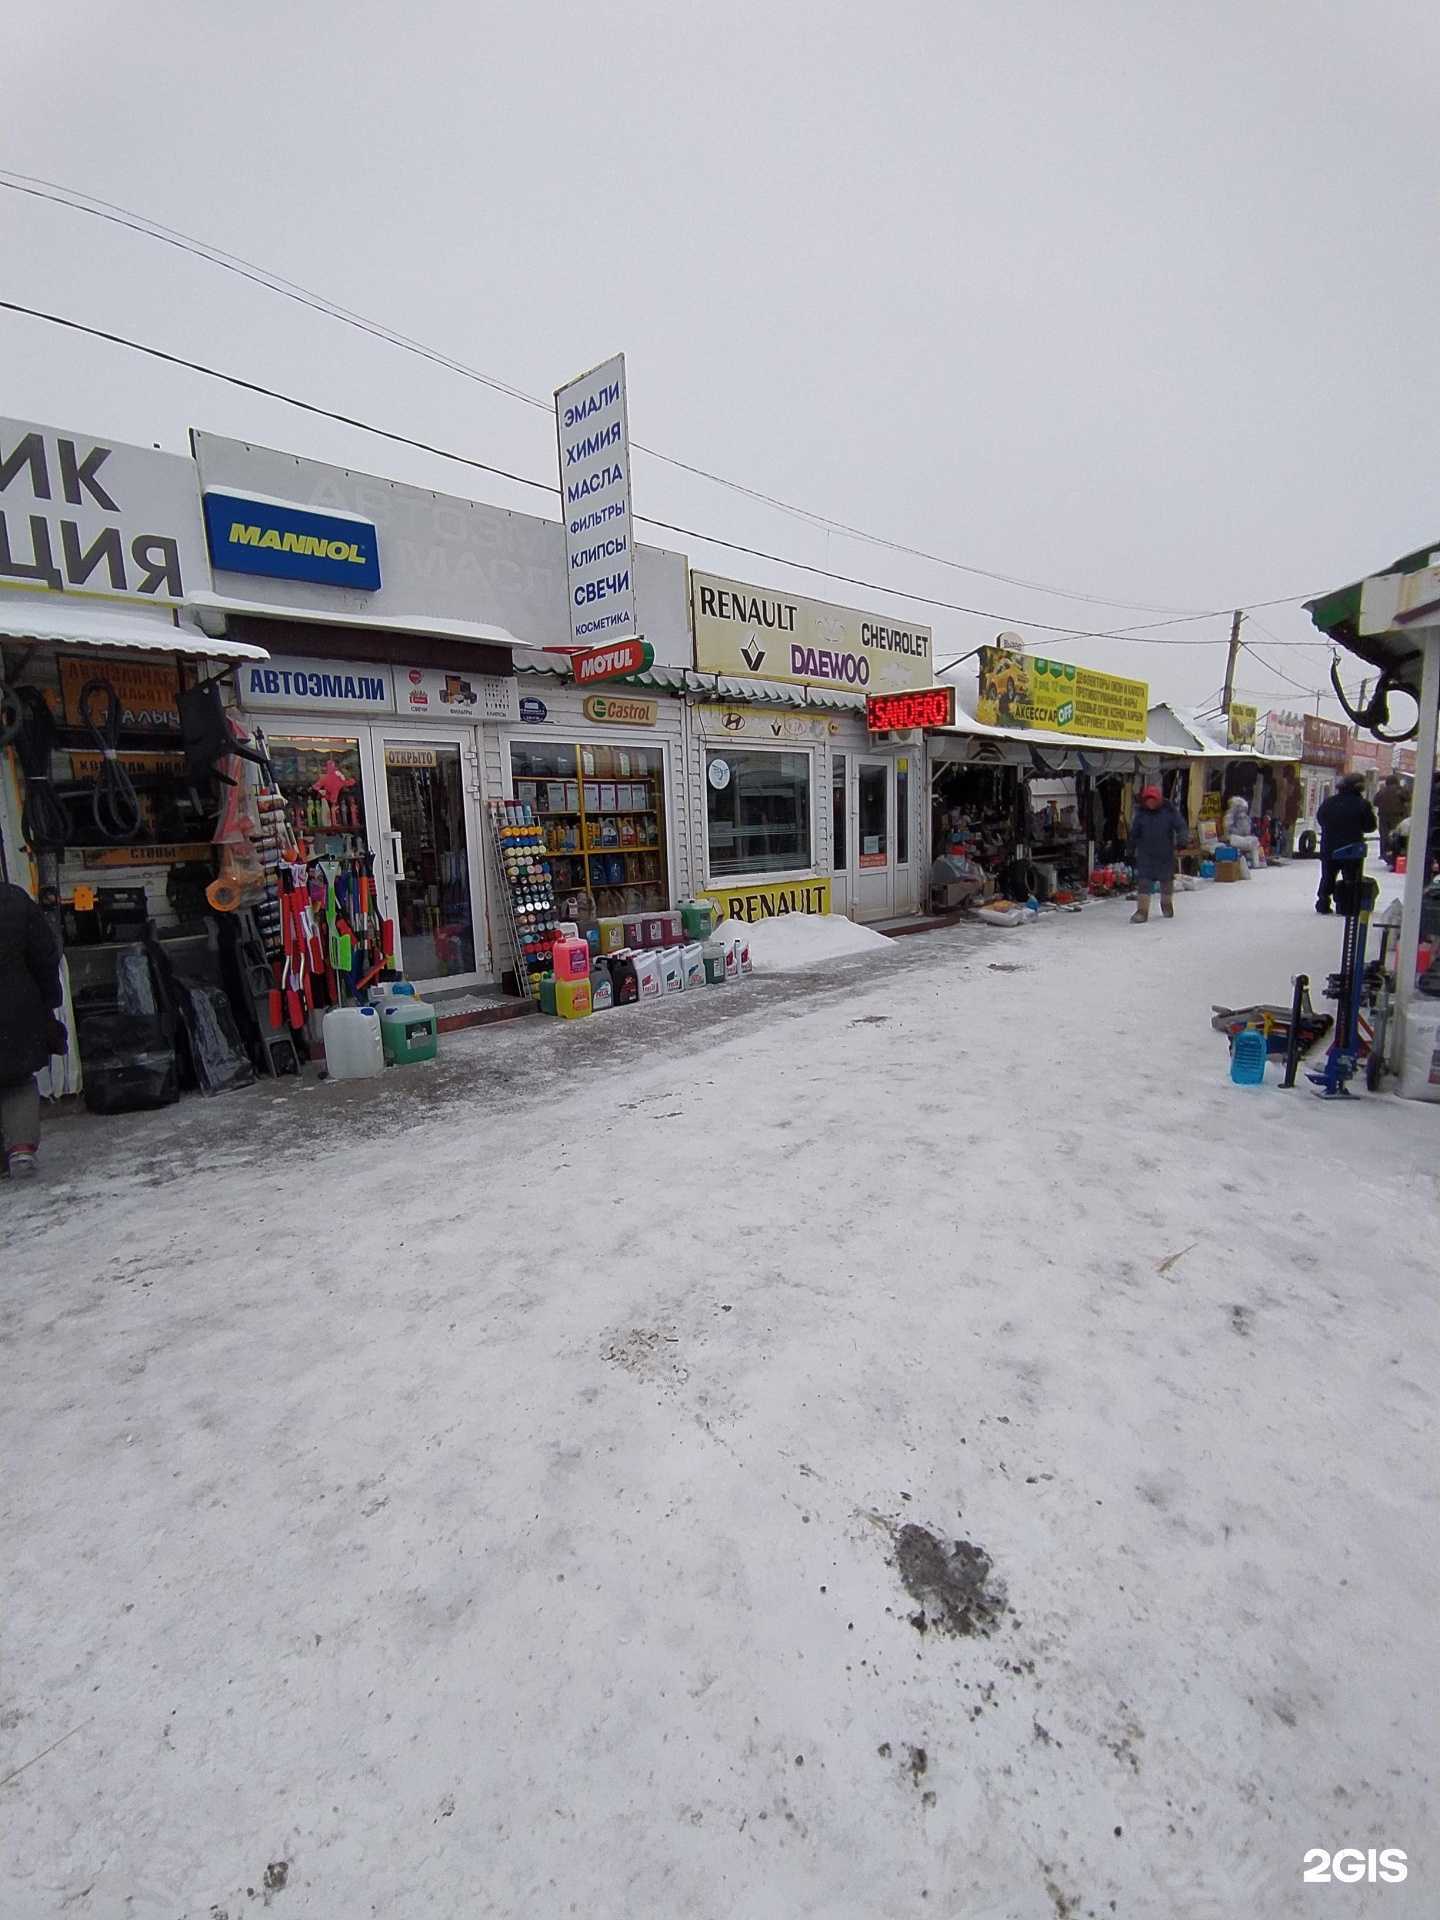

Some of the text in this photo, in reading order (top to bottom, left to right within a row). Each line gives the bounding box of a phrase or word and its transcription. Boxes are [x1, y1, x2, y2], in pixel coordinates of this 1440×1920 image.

[564, 381, 620, 428] ЭМАЛИ
[566, 422, 622, 467] ХИМИЯ
[567, 463, 623, 503] МАСЛА
[570, 500, 625, 535] ФИЛЬТРЫ
[229, 522, 366, 564] MANNOL
[571, 535, 627, 569] КЛИПСЫ
[574, 570, 630, 606] СВЕЧИ
[575, 611, 631, 637] КОСМЕТИКА
[699, 585, 798, 632] RENAULT
[861, 622, 929, 658] CHEVROLET
[581, 647, 633, 679] MOTUL
[790, 643, 870, 685] DAEWOO
[250, 669, 385, 701] АВТОЭМАЛИ
[608, 702, 650, 720] Castrol
[874, 691, 947, 729] SANDERO
[389, 750, 433, 765] ОТКРЫТО
[728, 886, 826, 923] RENAULT
